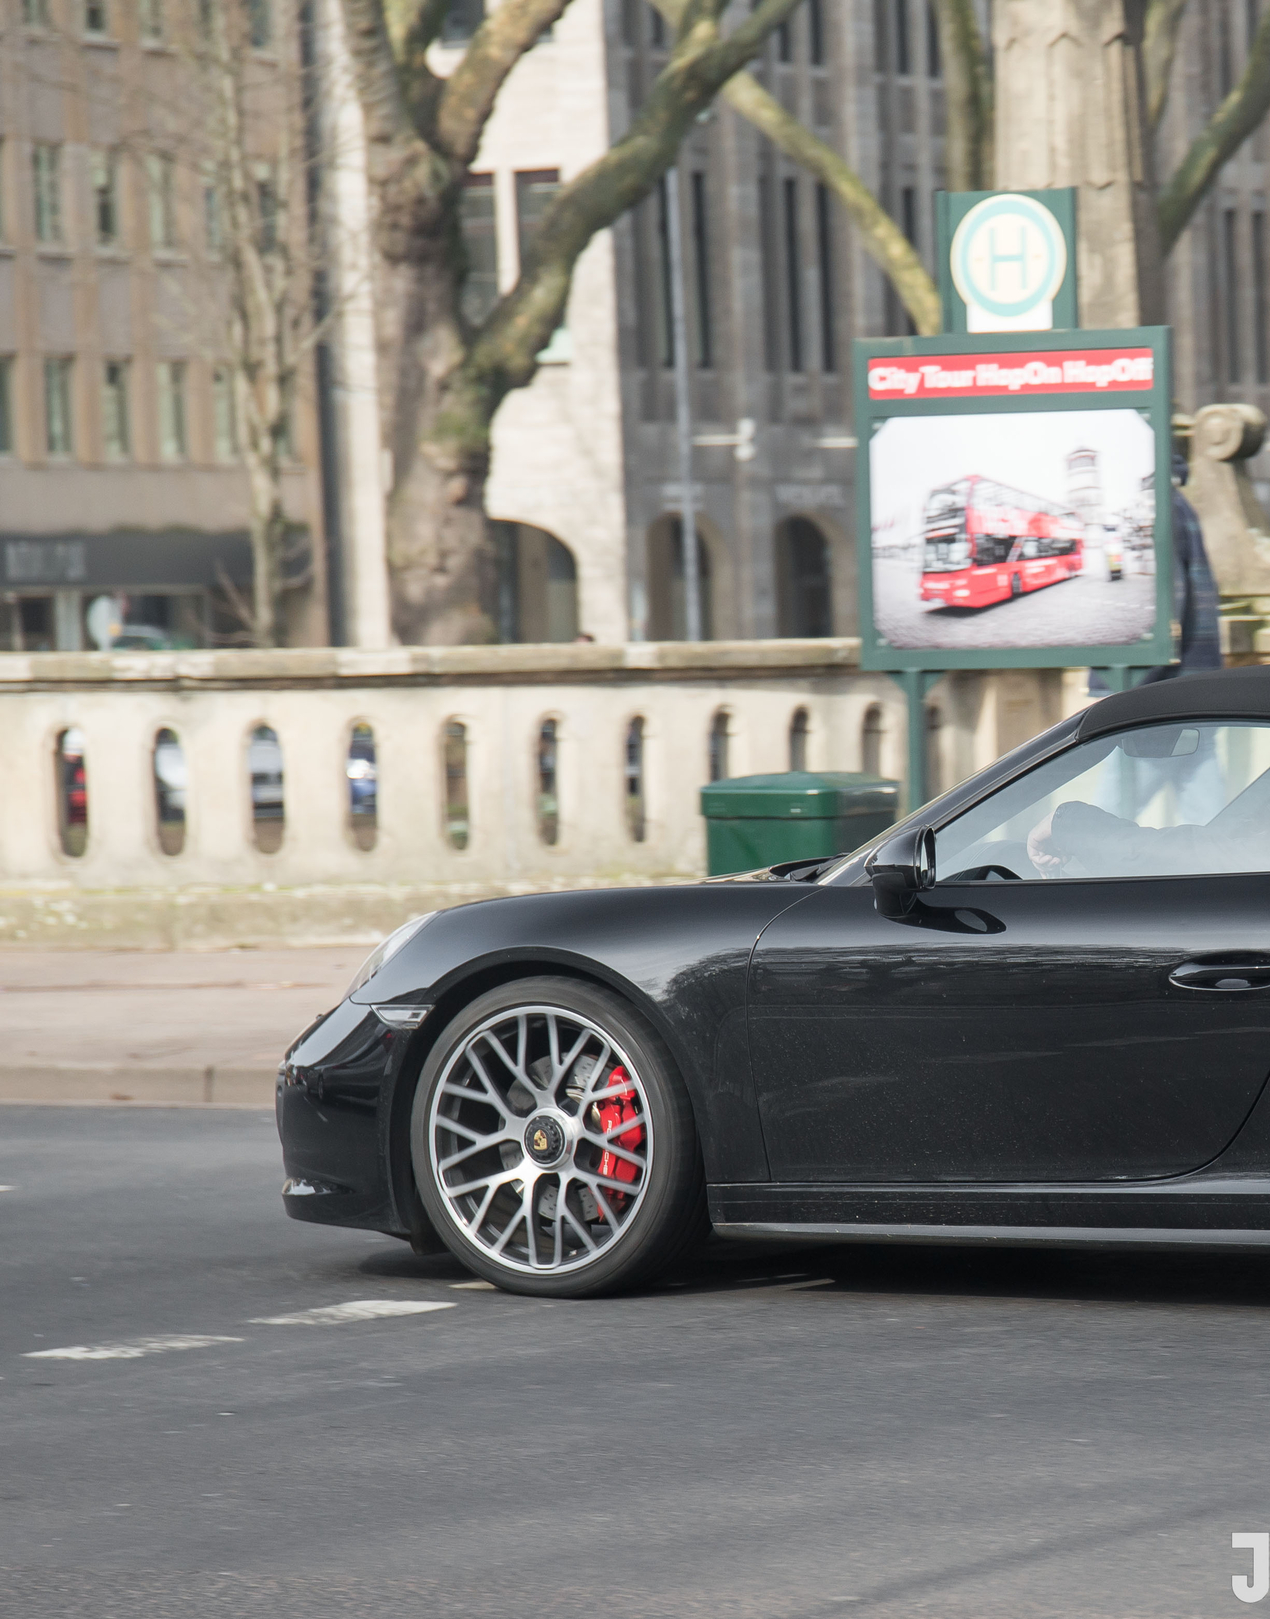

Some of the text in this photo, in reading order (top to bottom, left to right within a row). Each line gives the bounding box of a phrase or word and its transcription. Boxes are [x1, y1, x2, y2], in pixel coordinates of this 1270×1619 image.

[988, 226, 1028, 291] H
[868, 367, 921, 394] City
[919, 365, 975, 388] Tour
